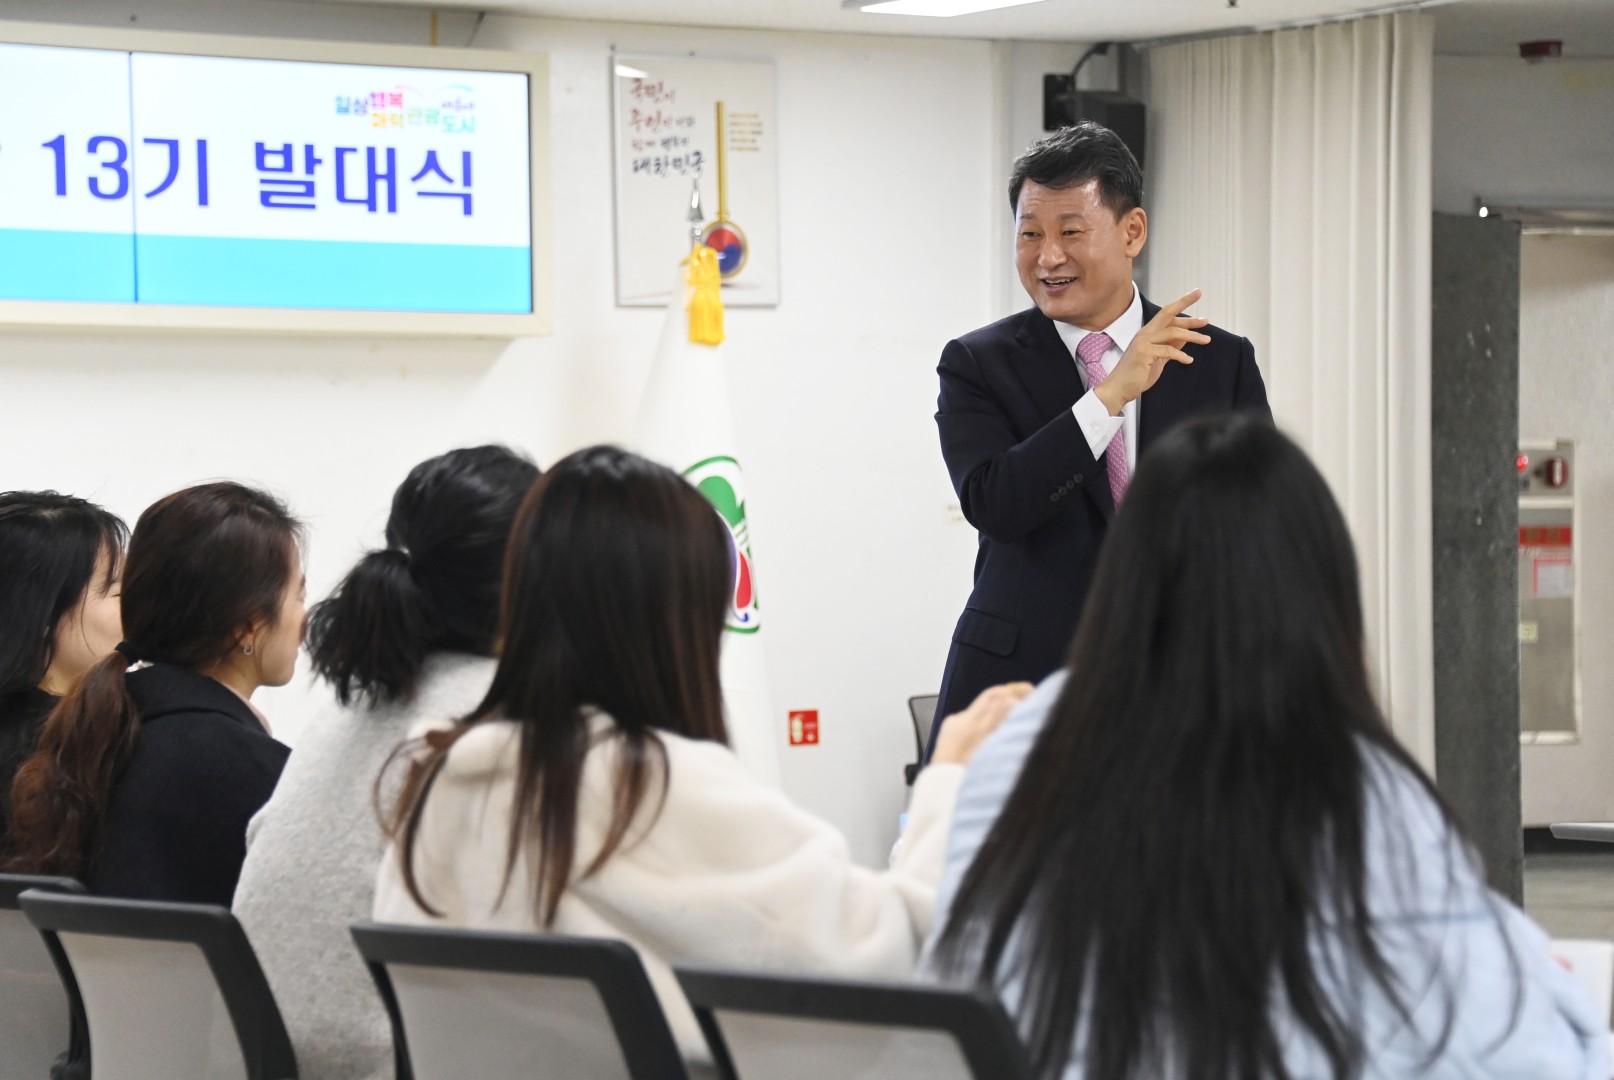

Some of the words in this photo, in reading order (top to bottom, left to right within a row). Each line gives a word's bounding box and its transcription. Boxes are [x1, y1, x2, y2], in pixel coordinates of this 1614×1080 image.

[42, 134, 209, 206] 13기
[254, 141, 473, 215] 발대식
[632, 151, 704, 176] 대한민국
